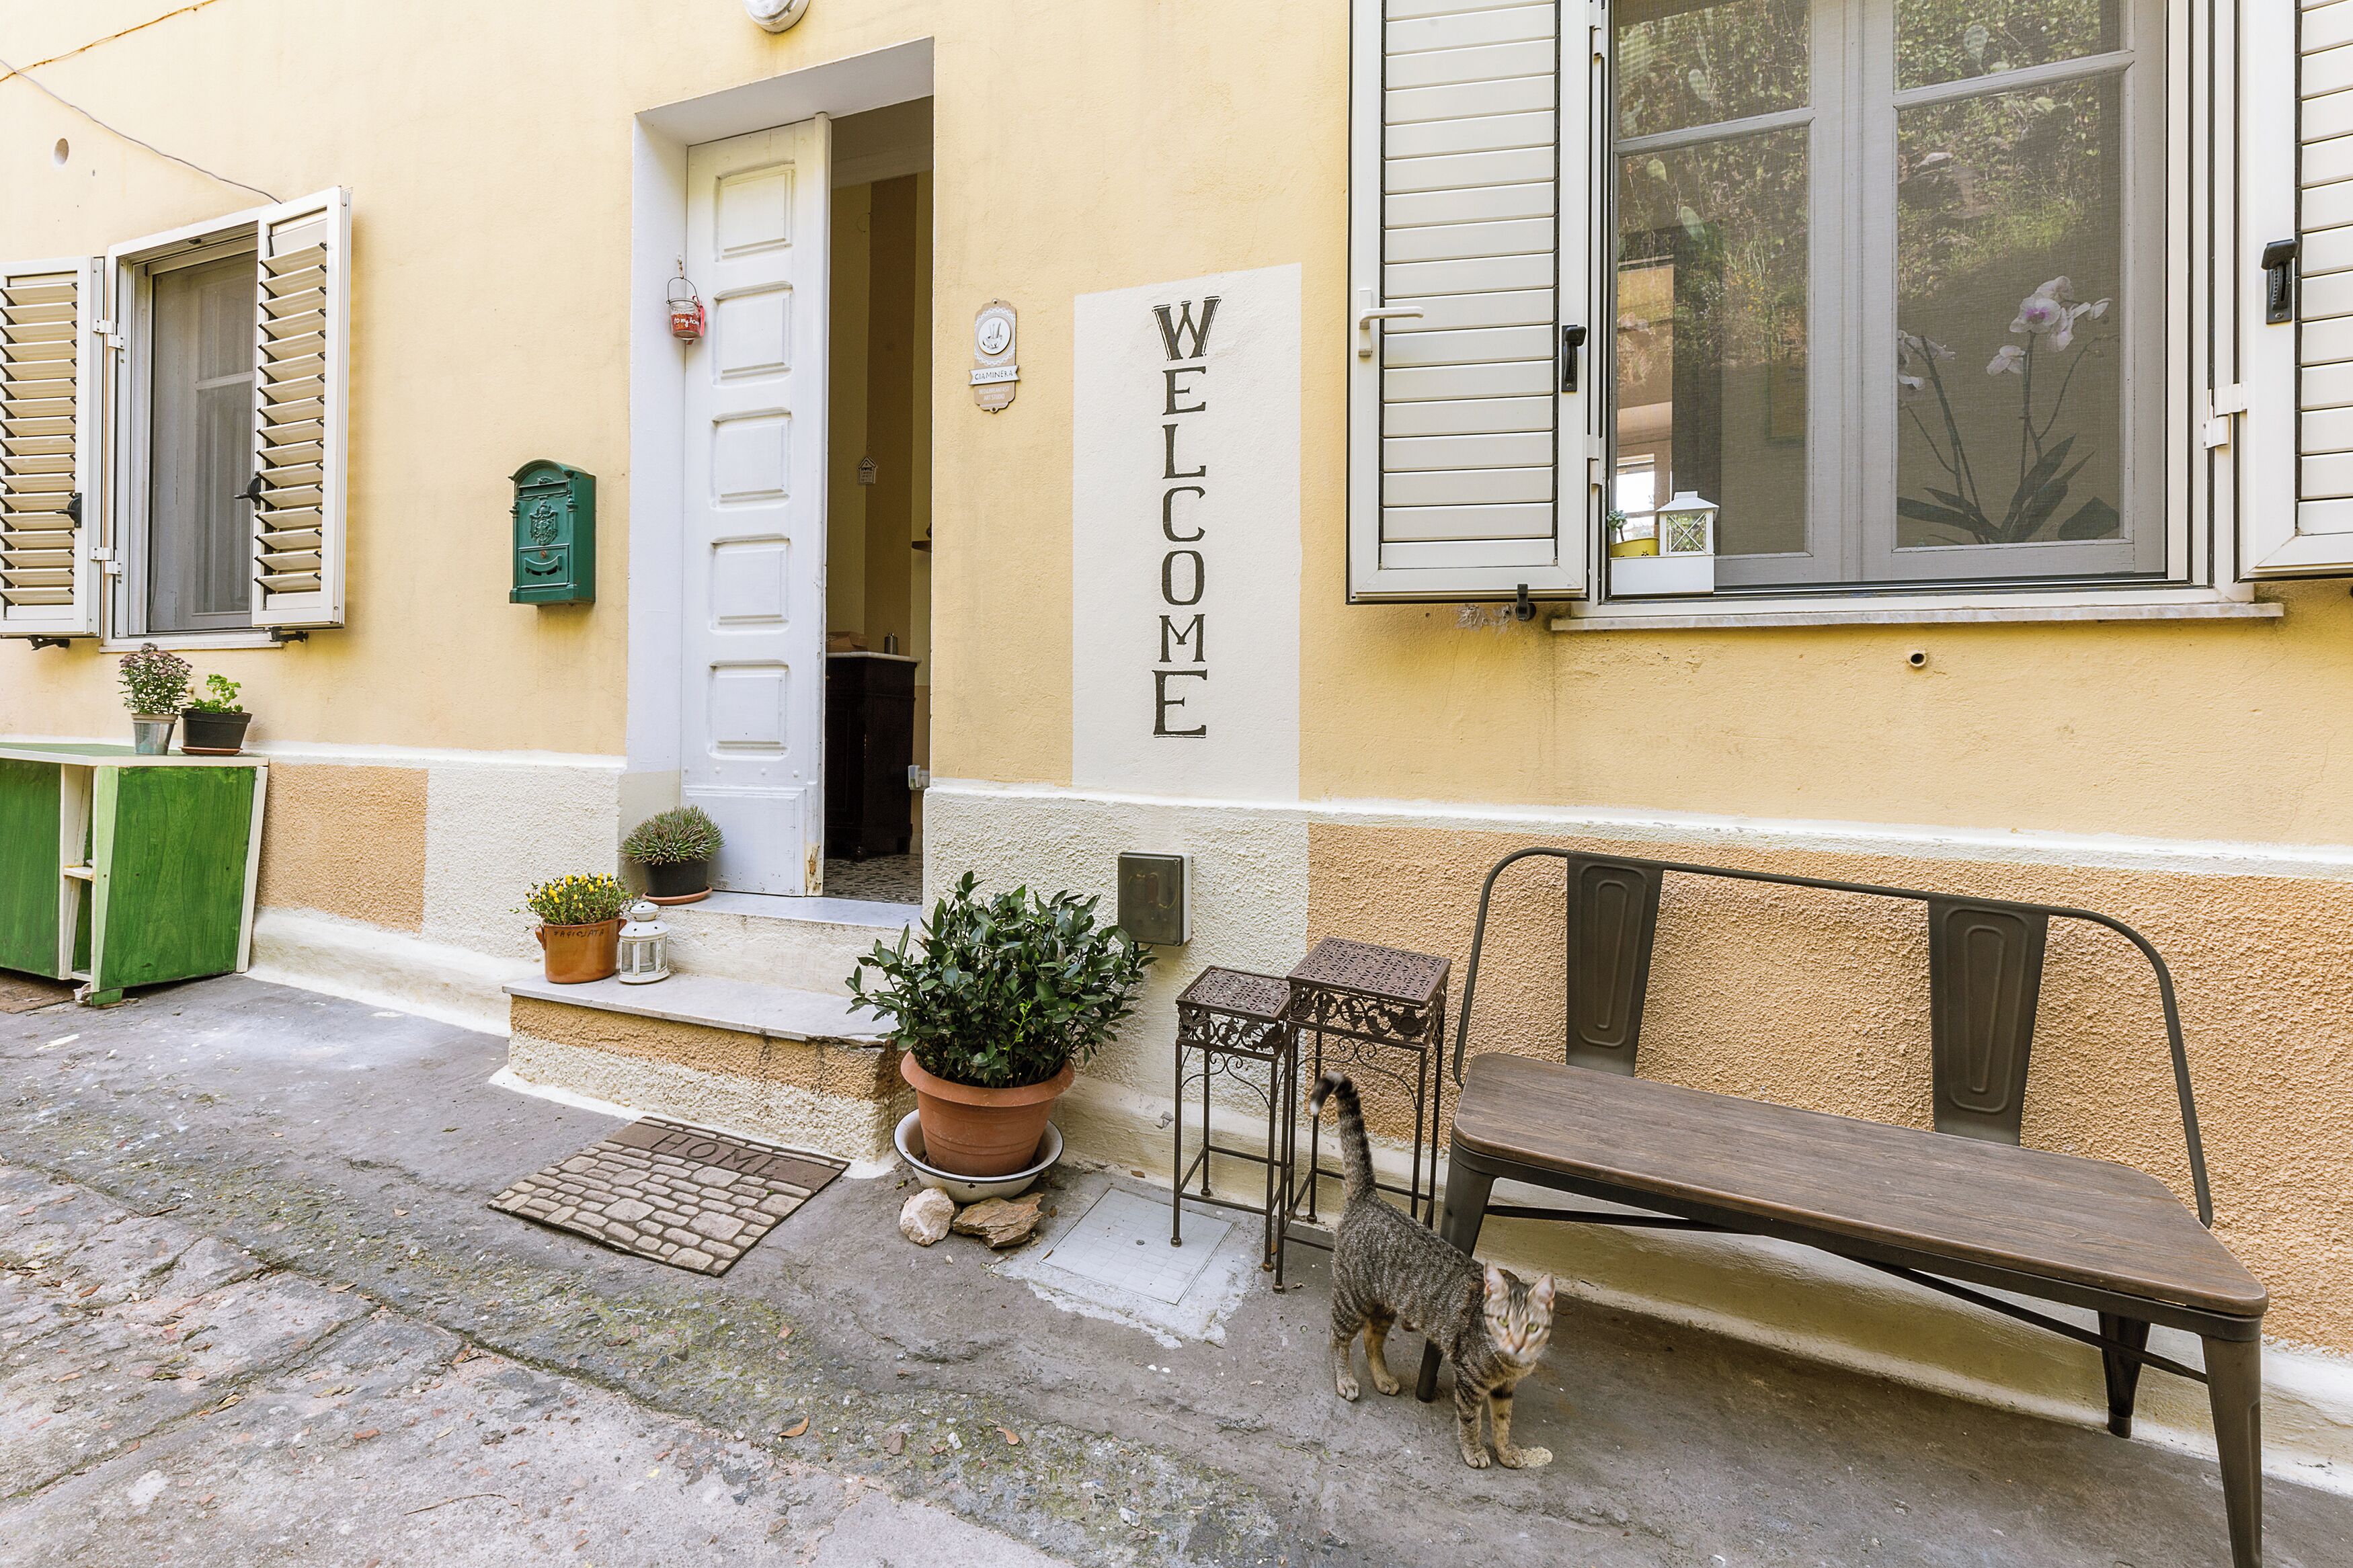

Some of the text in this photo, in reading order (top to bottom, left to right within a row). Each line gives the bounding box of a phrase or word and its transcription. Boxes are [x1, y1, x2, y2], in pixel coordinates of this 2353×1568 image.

[680, 319, 688, 327] my
[1152, 296, 1222, 739] WELCOME
[650, 1132, 791, 1177] HOME
